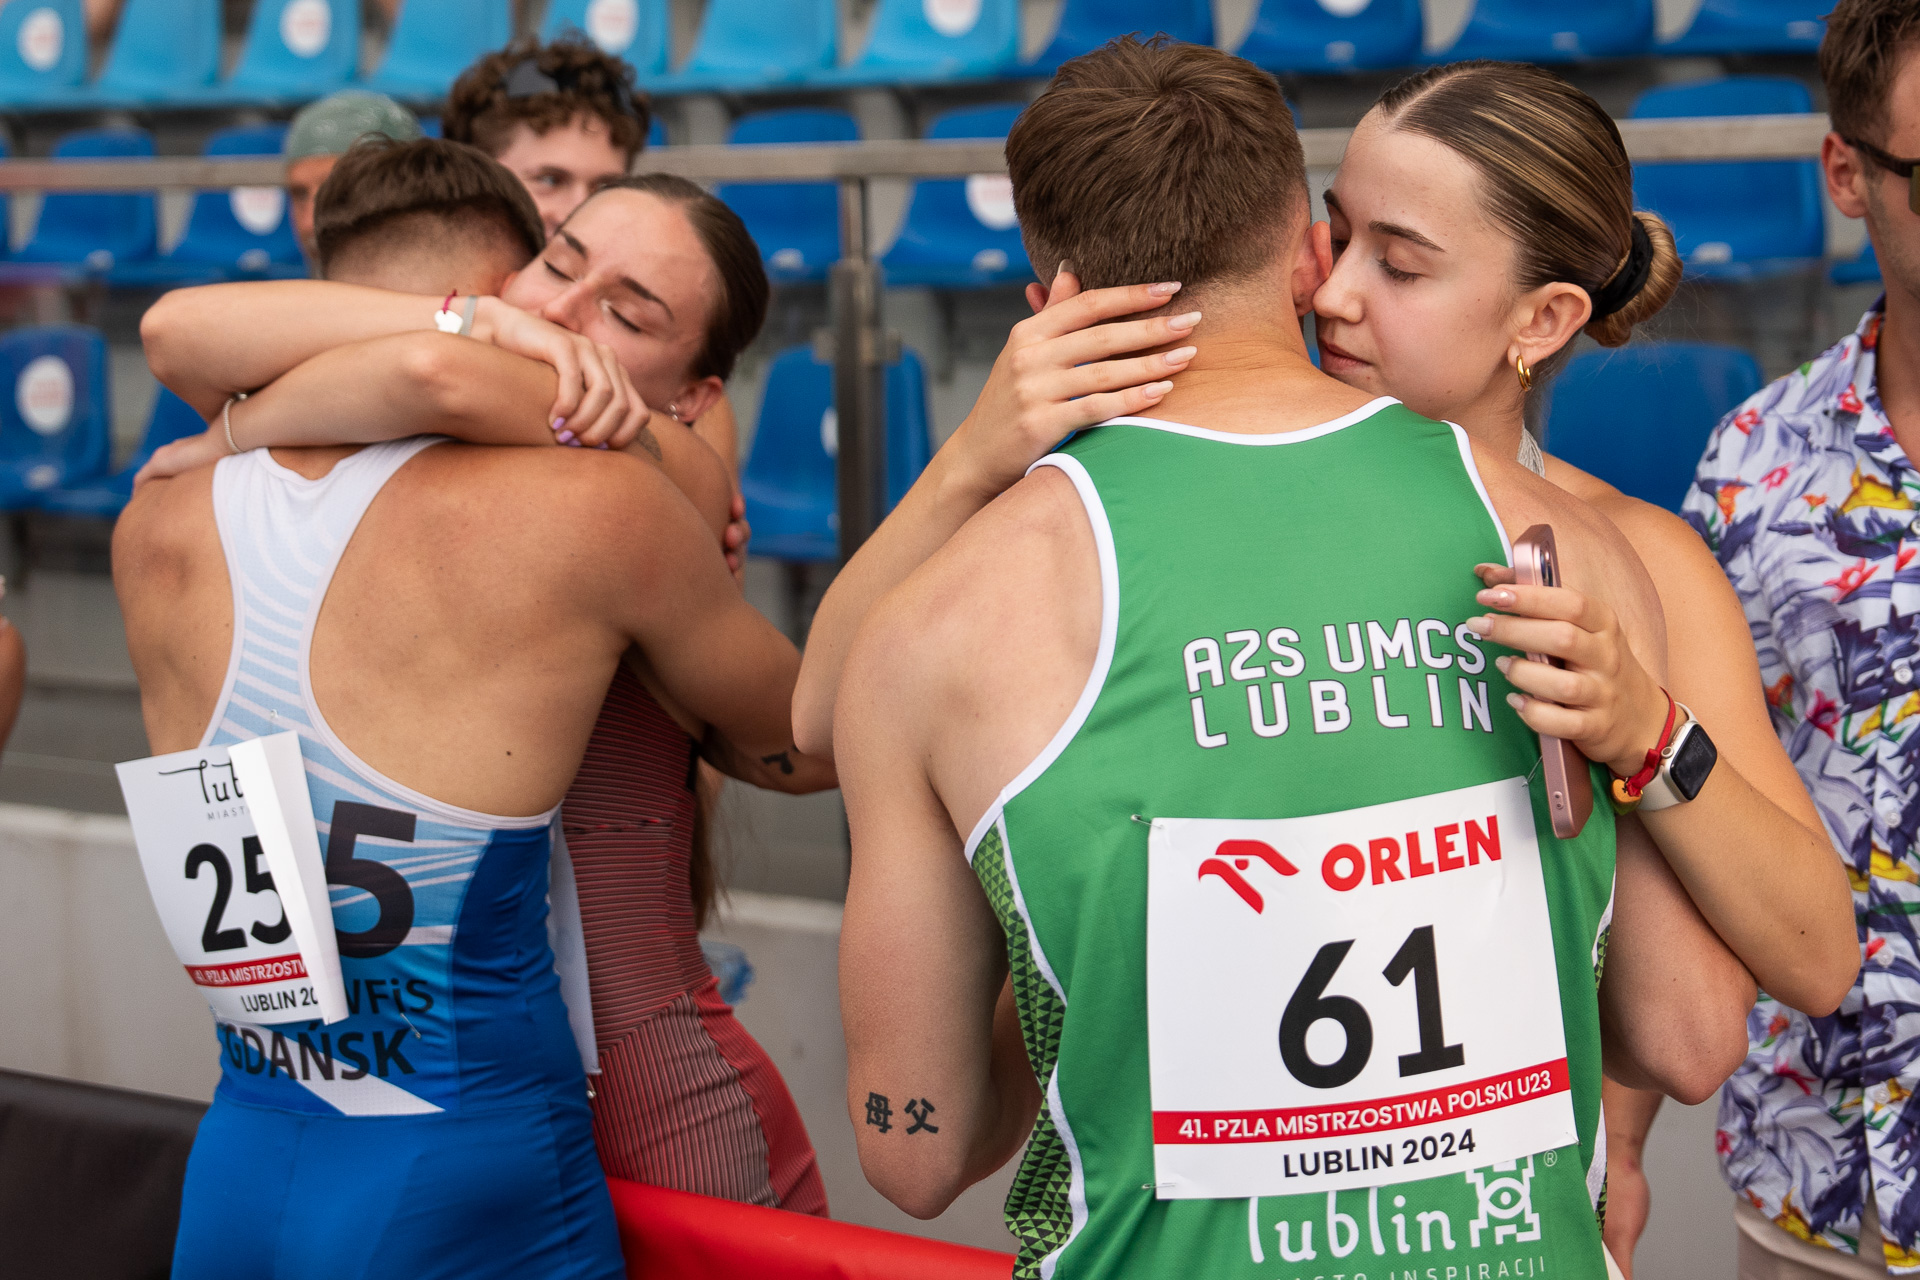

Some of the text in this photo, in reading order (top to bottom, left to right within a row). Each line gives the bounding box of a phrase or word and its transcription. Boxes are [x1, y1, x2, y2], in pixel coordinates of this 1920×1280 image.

[1182, 618, 1487, 693] AZS UMCS
[1189, 674, 1494, 749] LUBLIN
[207, 805, 247, 821] MIAST
[1321, 815, 1502, 892] ORLEN
[184, 835, 292, 953] 25
[240, 989, 297, 1013] LUBLIN
[1278, 924, 1466, 1089] 61
[225, 1021, 417, 1081] GDAŃSK
[1178, 1069, 1552, 1139] 41. PZLA MISTRZOSTWA POLSKI U23
[1283, 1128, 1476, 1178] LUBLIN 2024
